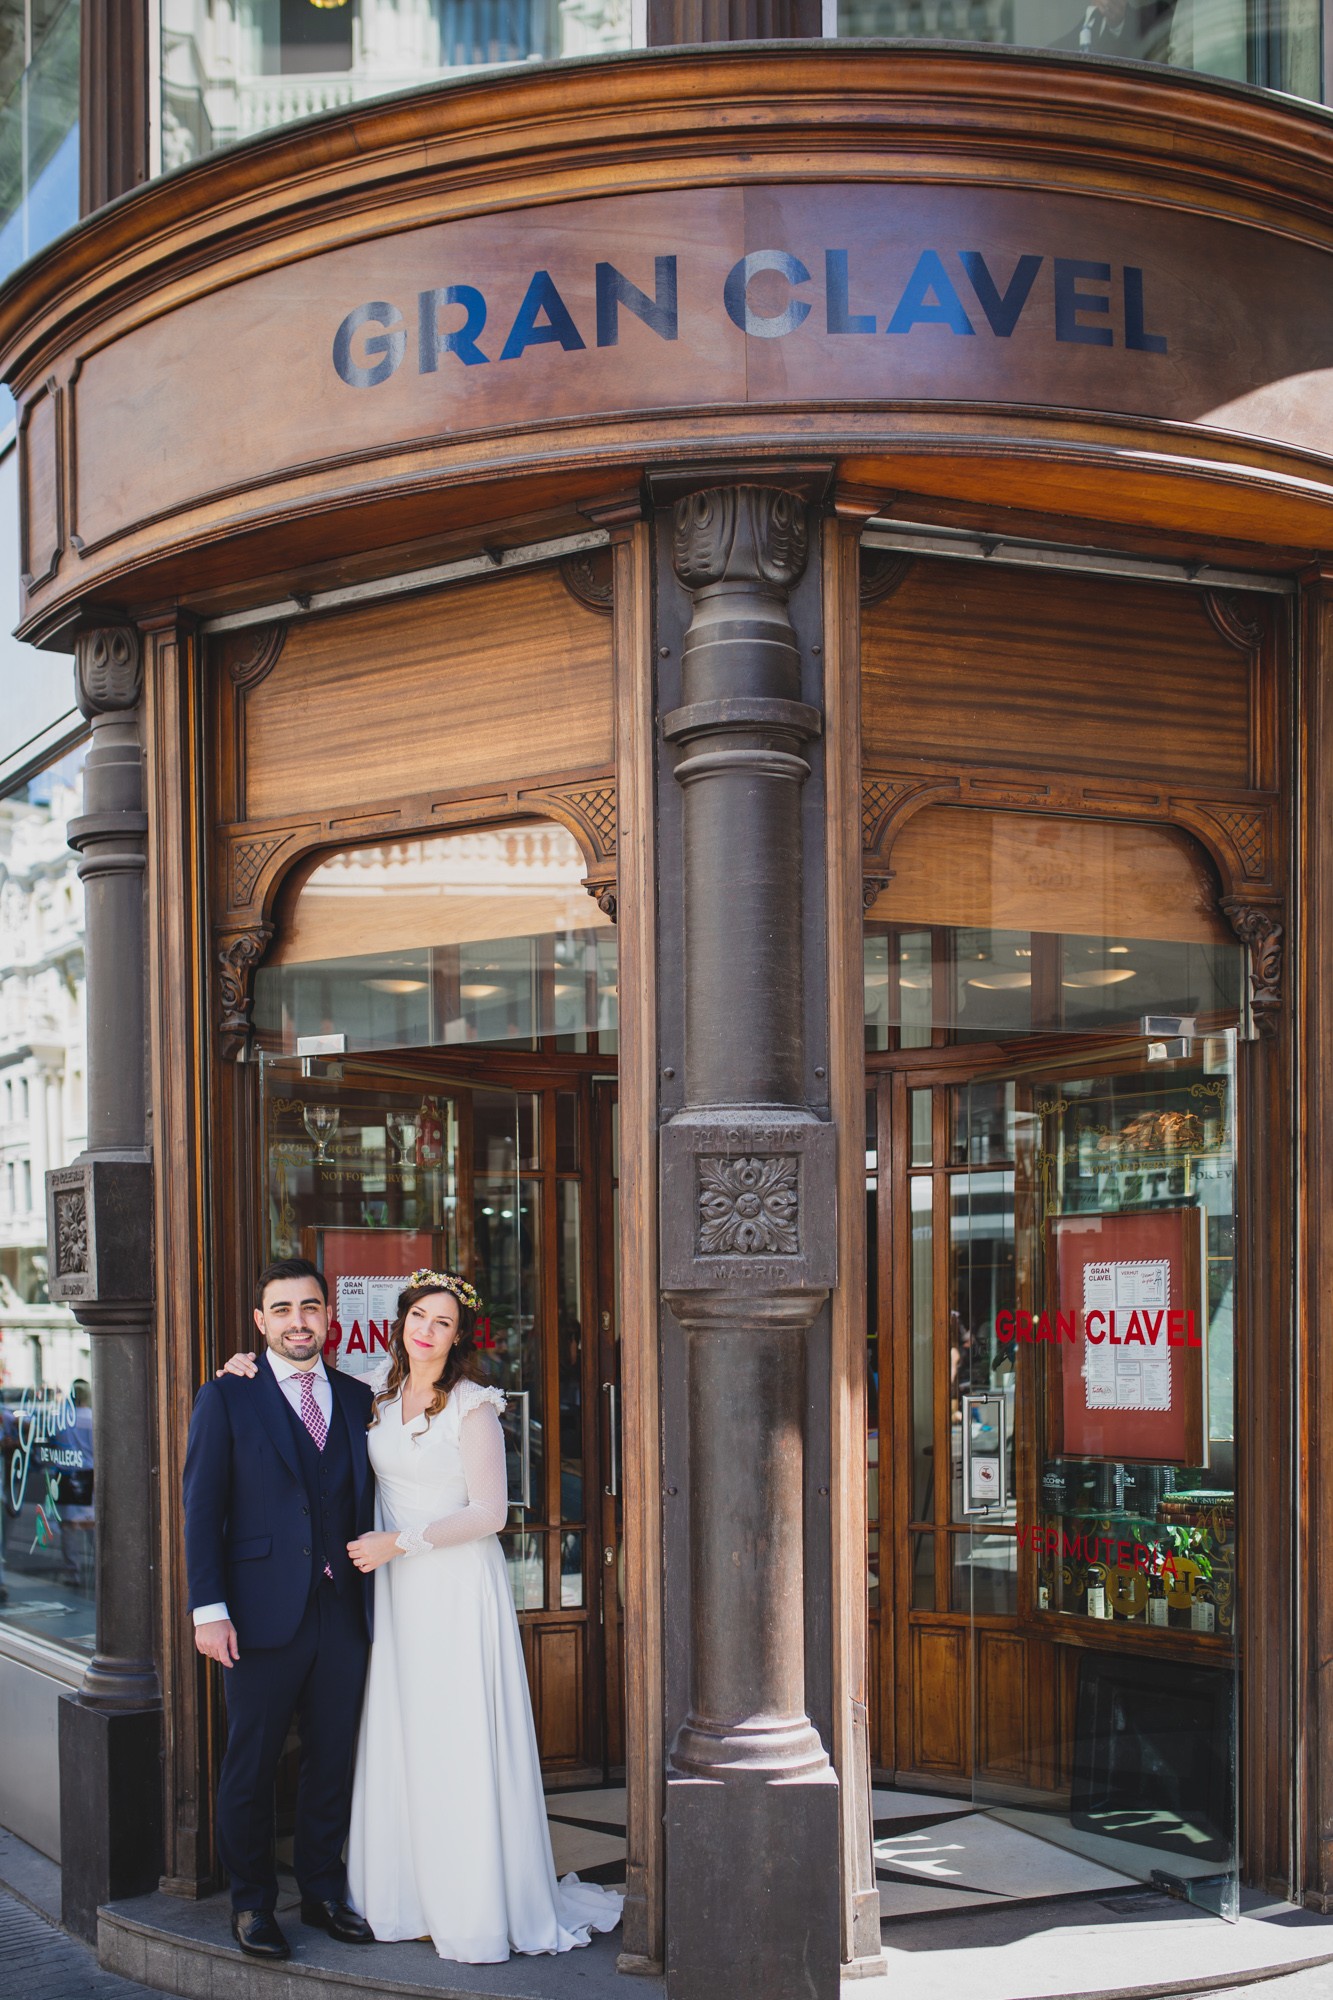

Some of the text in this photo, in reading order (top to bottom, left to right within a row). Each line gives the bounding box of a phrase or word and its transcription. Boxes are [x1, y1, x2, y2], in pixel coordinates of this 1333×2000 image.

[332, 249, 1167, 388] GRAN CLAVEL
[321, 1171, 343, 1181] NOT
[346, 1172, 366, 1181] FOR
[713, 1265, 788, 1280] MADRID
[1090, 1267, 1110, 1275] GRAN
[323, 1319, 390, 1355] RAN
[995, 1309, 1202, 1347] GRAN CLAVEL
[40, 1447, 83, 1469] DE VALLECAS
[1015, 1522, 1179, 1580] VERMUTERÍA
